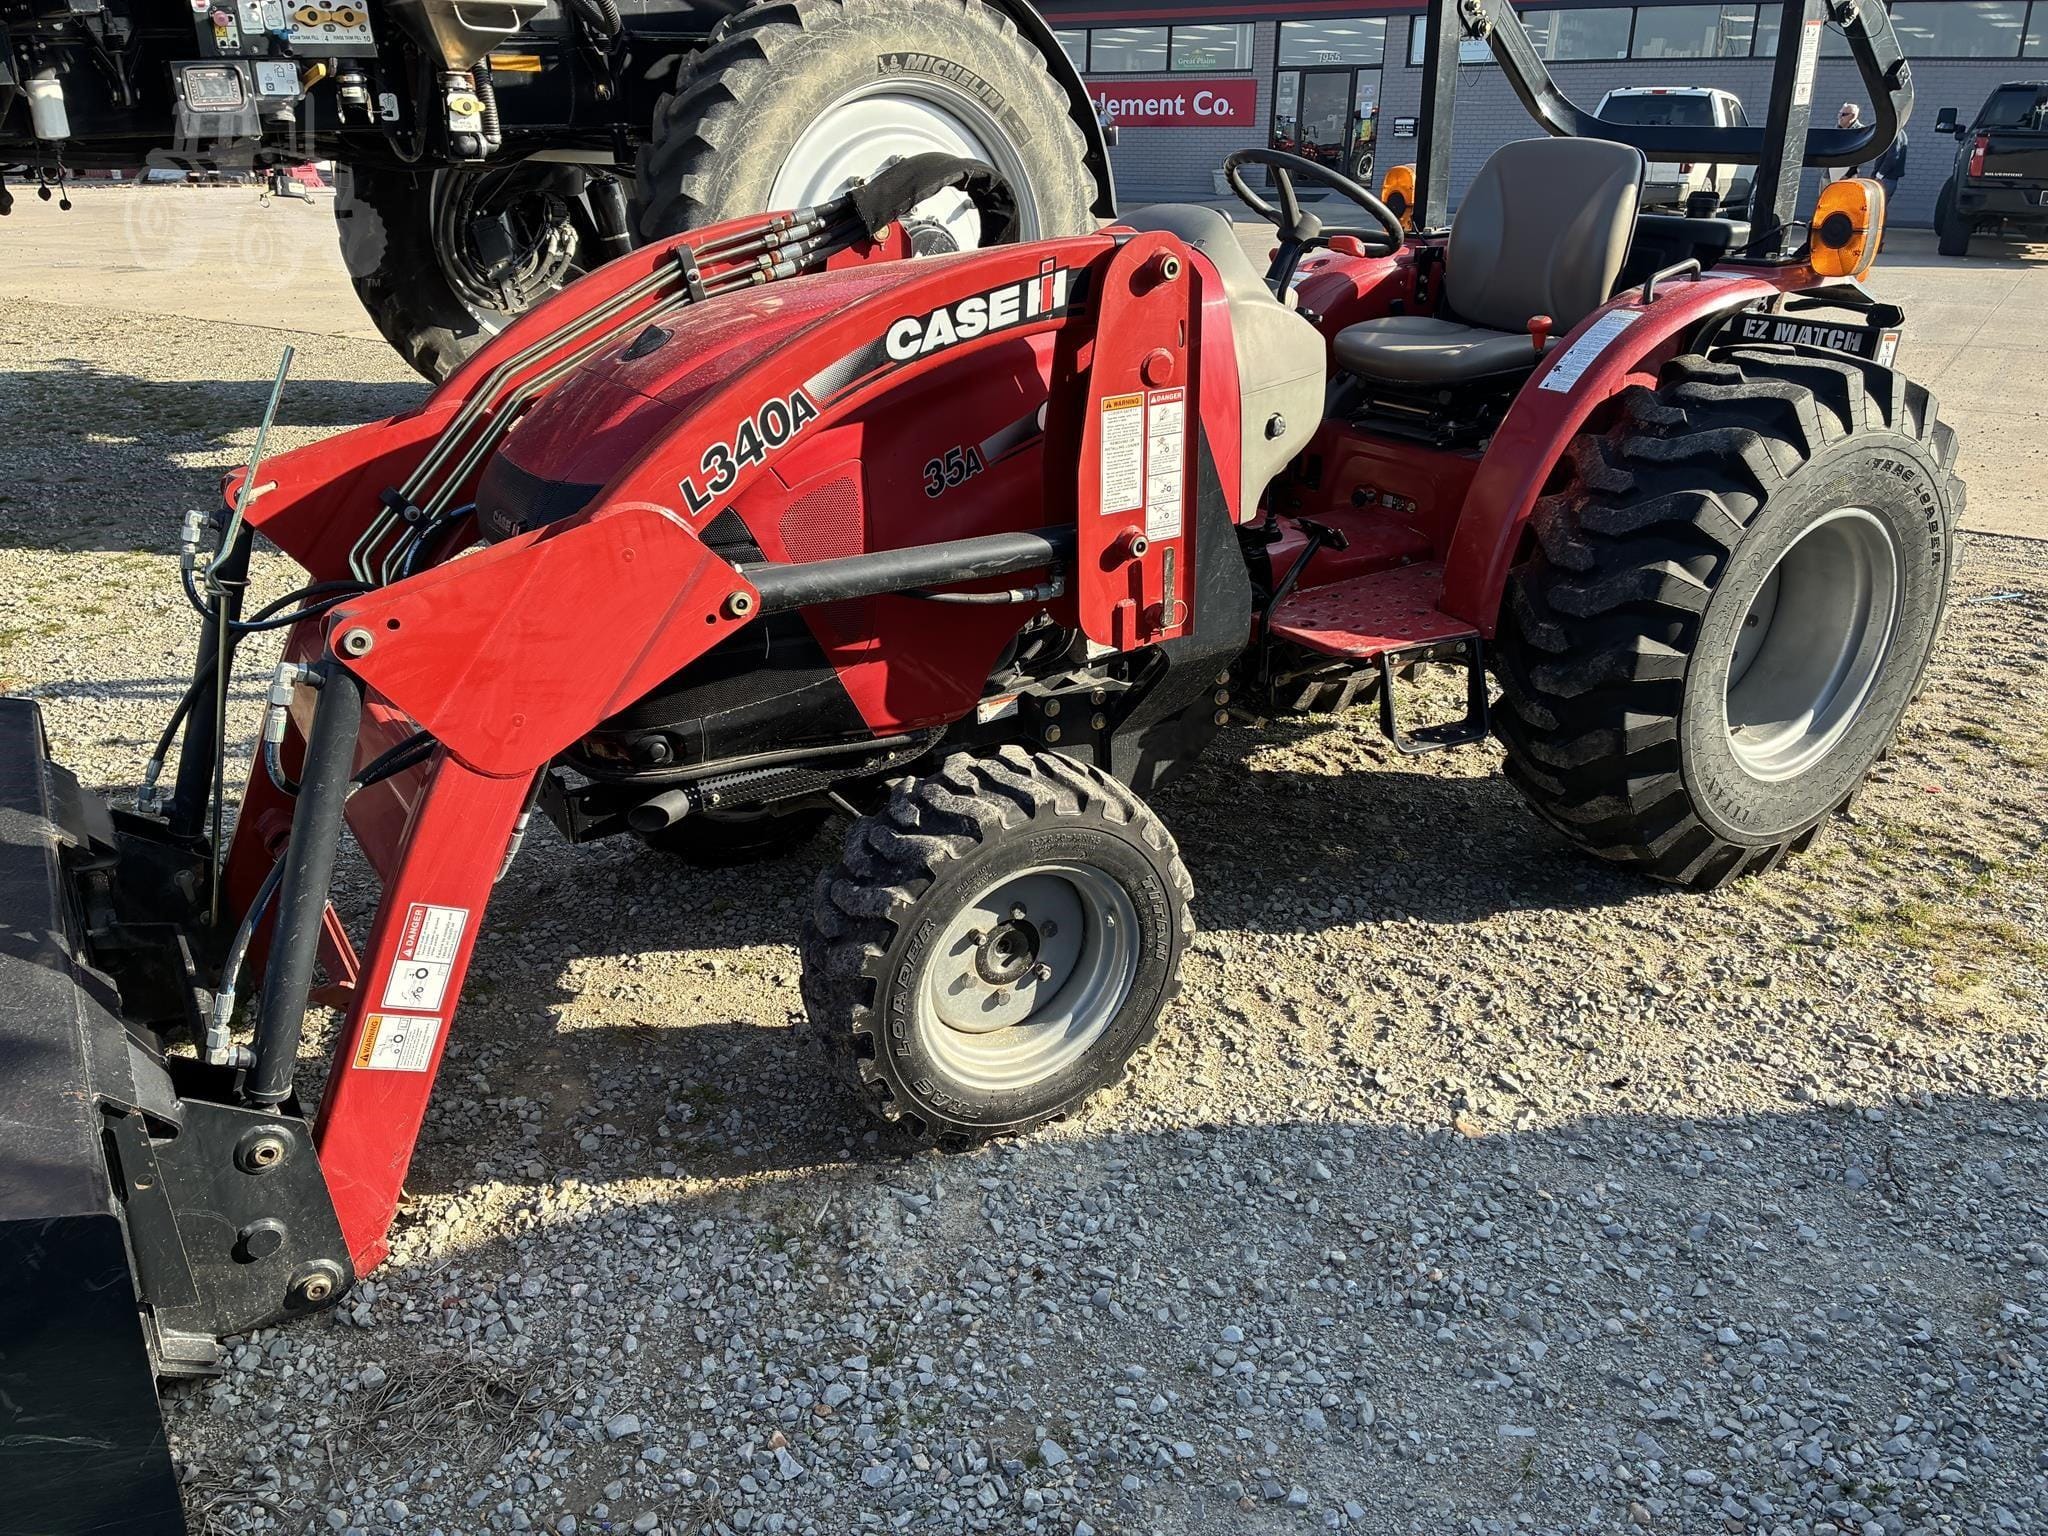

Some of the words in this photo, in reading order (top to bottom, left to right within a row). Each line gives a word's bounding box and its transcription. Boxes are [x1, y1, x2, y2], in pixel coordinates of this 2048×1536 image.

[904, 54, 1004, 108] MICHELIN
[1092, 92, 1185, 116] lement
[1193, 91, 1235, 116] Co.
[886, 284, 1020, 360] CASE
[1742, 319, 1770, 339] EZ
[1774, 322, 1863, 352] MATCH
[1113, 398, 1139, 408] WARNING
[1156, 392, 1182, 402] DANGER
[678, 388, 820, 517] L340A
[923, 445, 984, 498] 35A
[1871, 458, 1916, 482] TRAC
[1913, 483, 1941, 566] LOADER
[406, 909, 423, 947] DANGER
[1142, 874, 1169, 962] TITAN
[891, 918, 937, 1057] LOADER
[363, 1020, 379, 1054] WARNING
